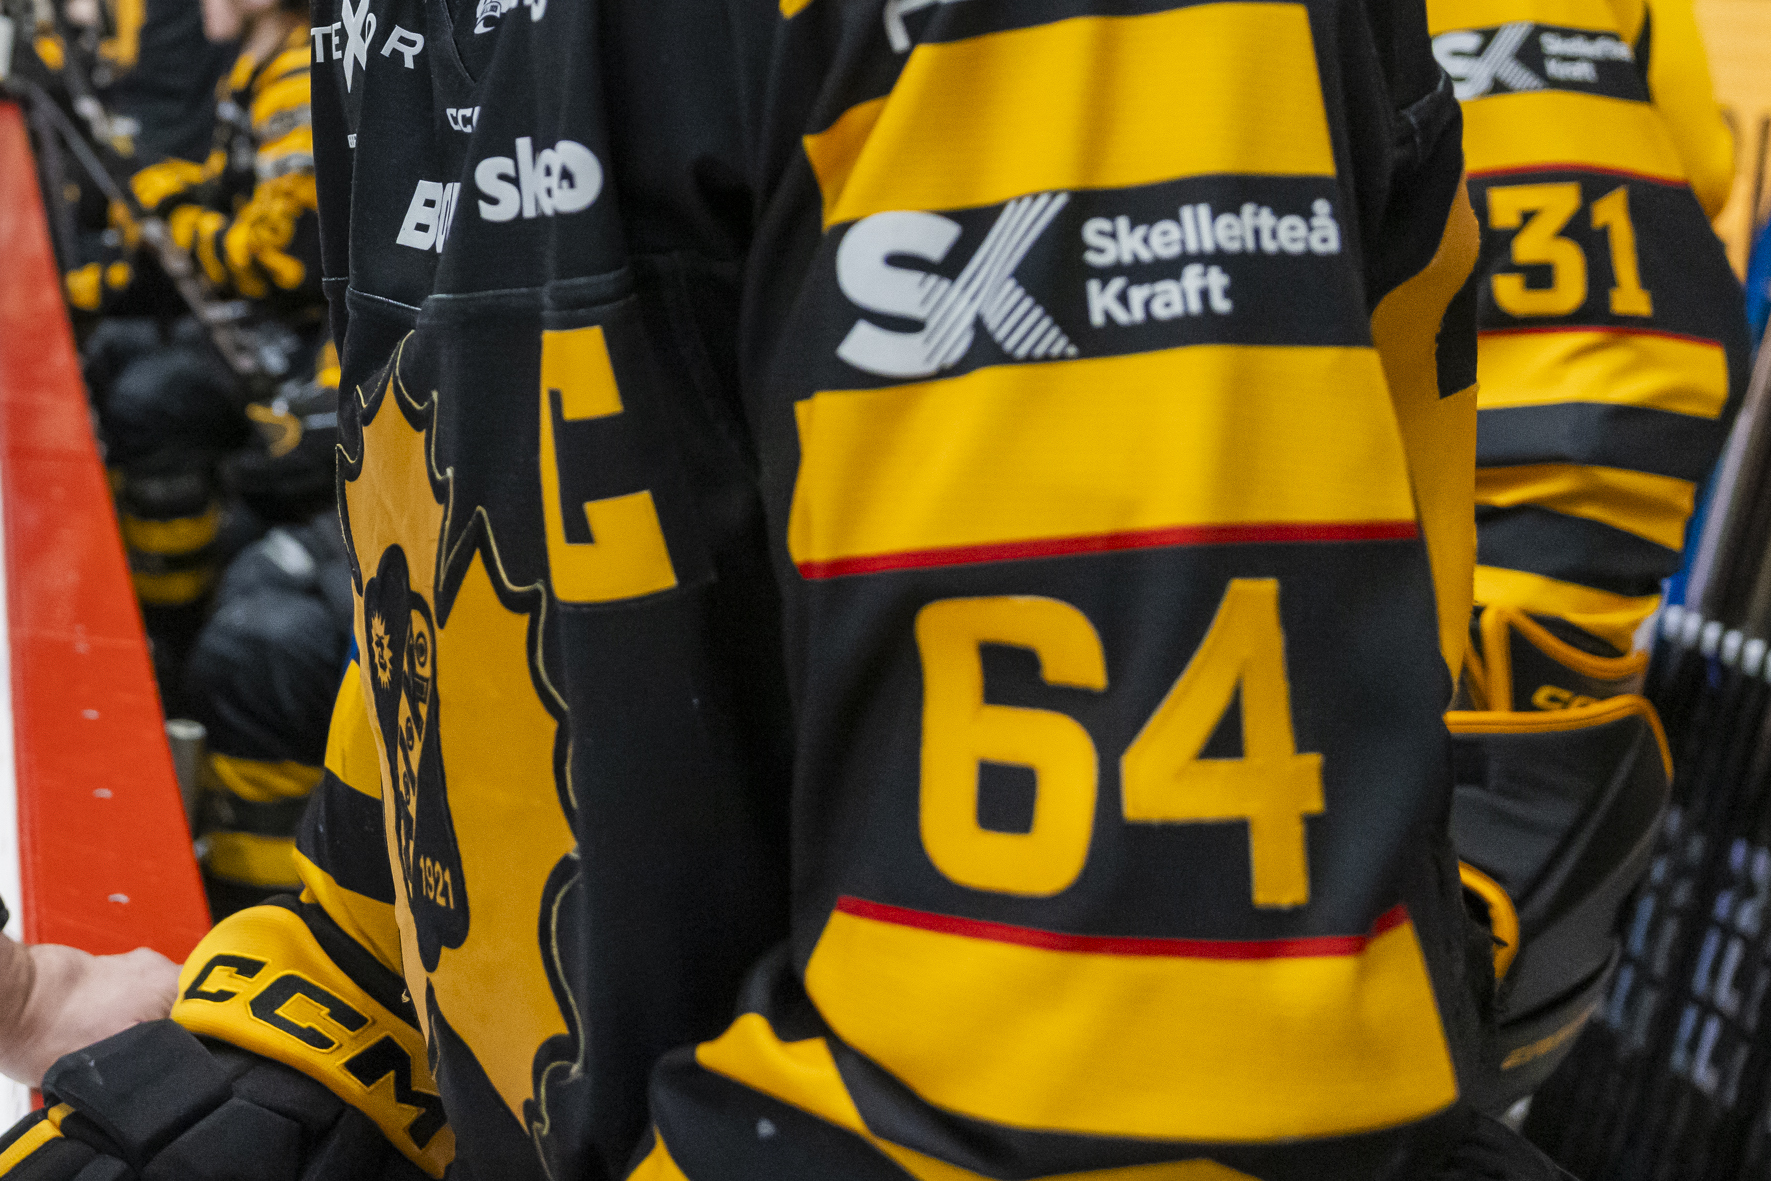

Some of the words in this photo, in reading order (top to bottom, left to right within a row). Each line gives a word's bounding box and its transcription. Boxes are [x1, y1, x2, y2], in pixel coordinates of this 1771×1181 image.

[1081, 198, 1340, 268] Skellefteå
[1086, 263, 1233, 328] Kraft
[1486, 182, 1653, 317] 31
[541, 325, 678, 603] C
[915, 577, 1324, 909] 64
[419, 855, 455, 910] 1921
[184, 954, 448, 1151] CCM
